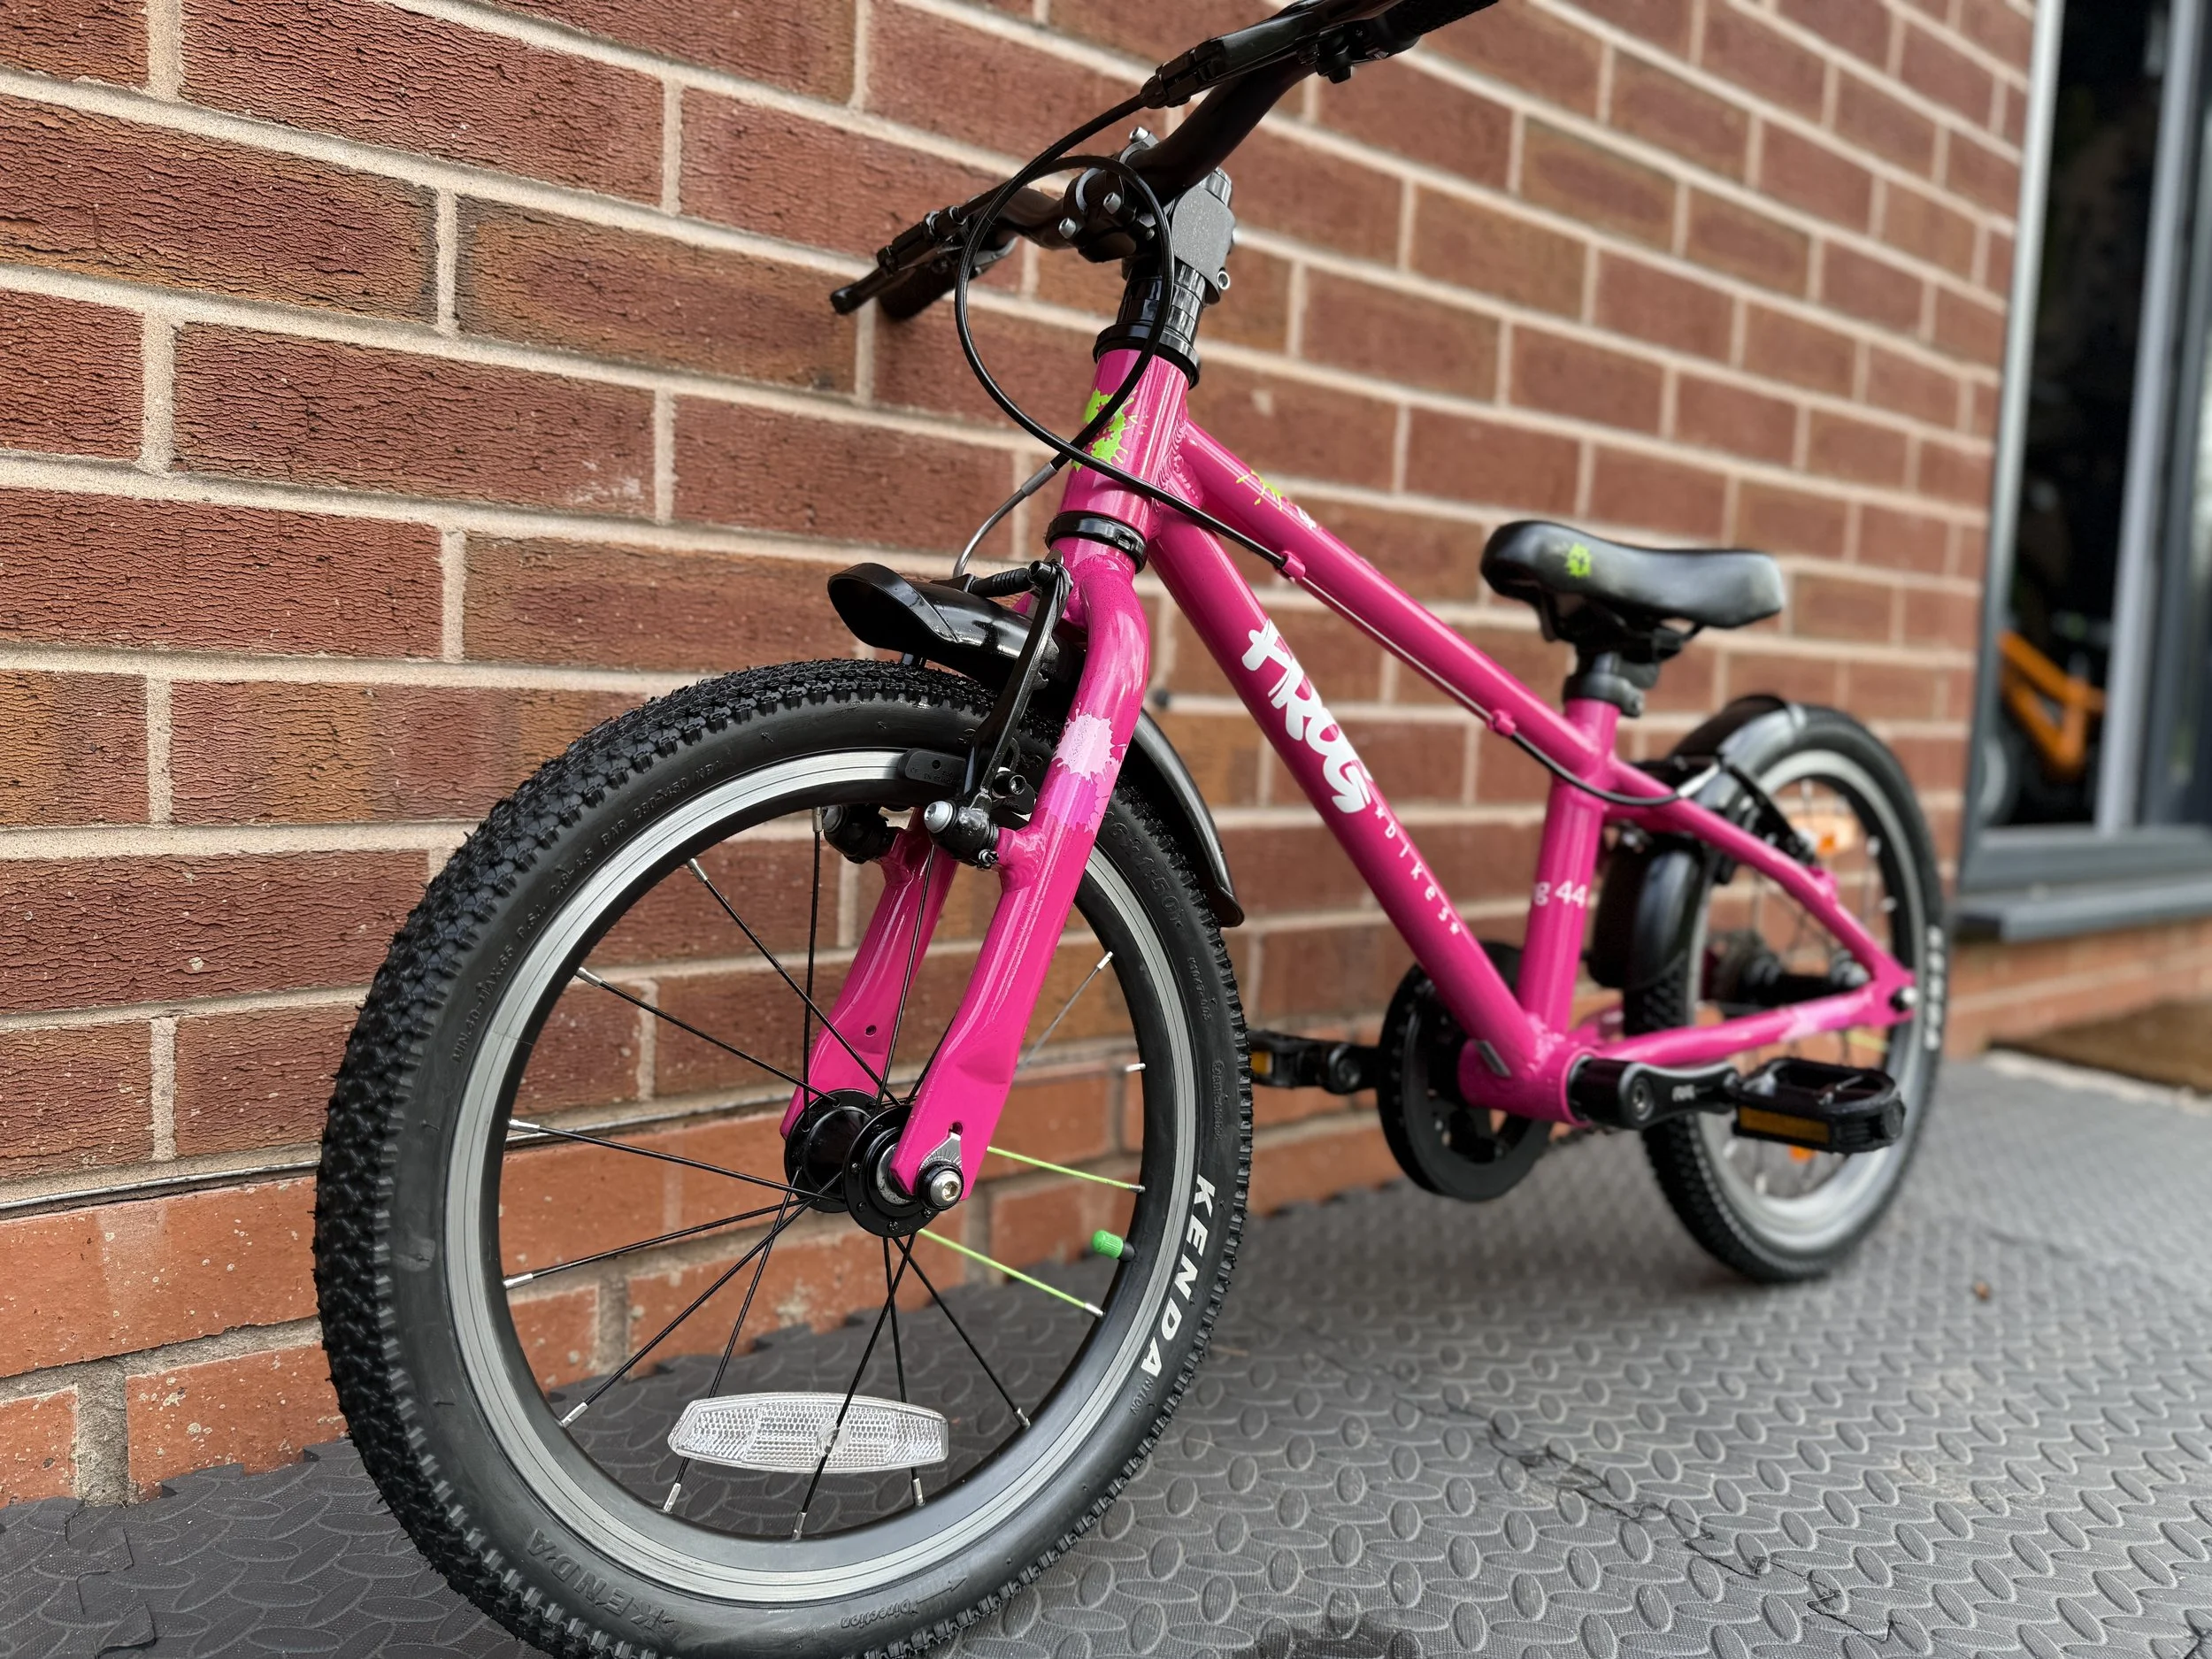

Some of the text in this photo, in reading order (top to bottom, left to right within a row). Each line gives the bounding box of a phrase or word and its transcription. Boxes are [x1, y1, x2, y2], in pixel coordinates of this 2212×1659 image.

[1555, 879, 1587, 909] 44
[1141, 1173, 1216, 1378] KENDA
[1130, 1379, 1155, 1416] NYLON
[527, 1528, 668, 1630] KENDA
[841, 1599, 912, 1630] Direction
